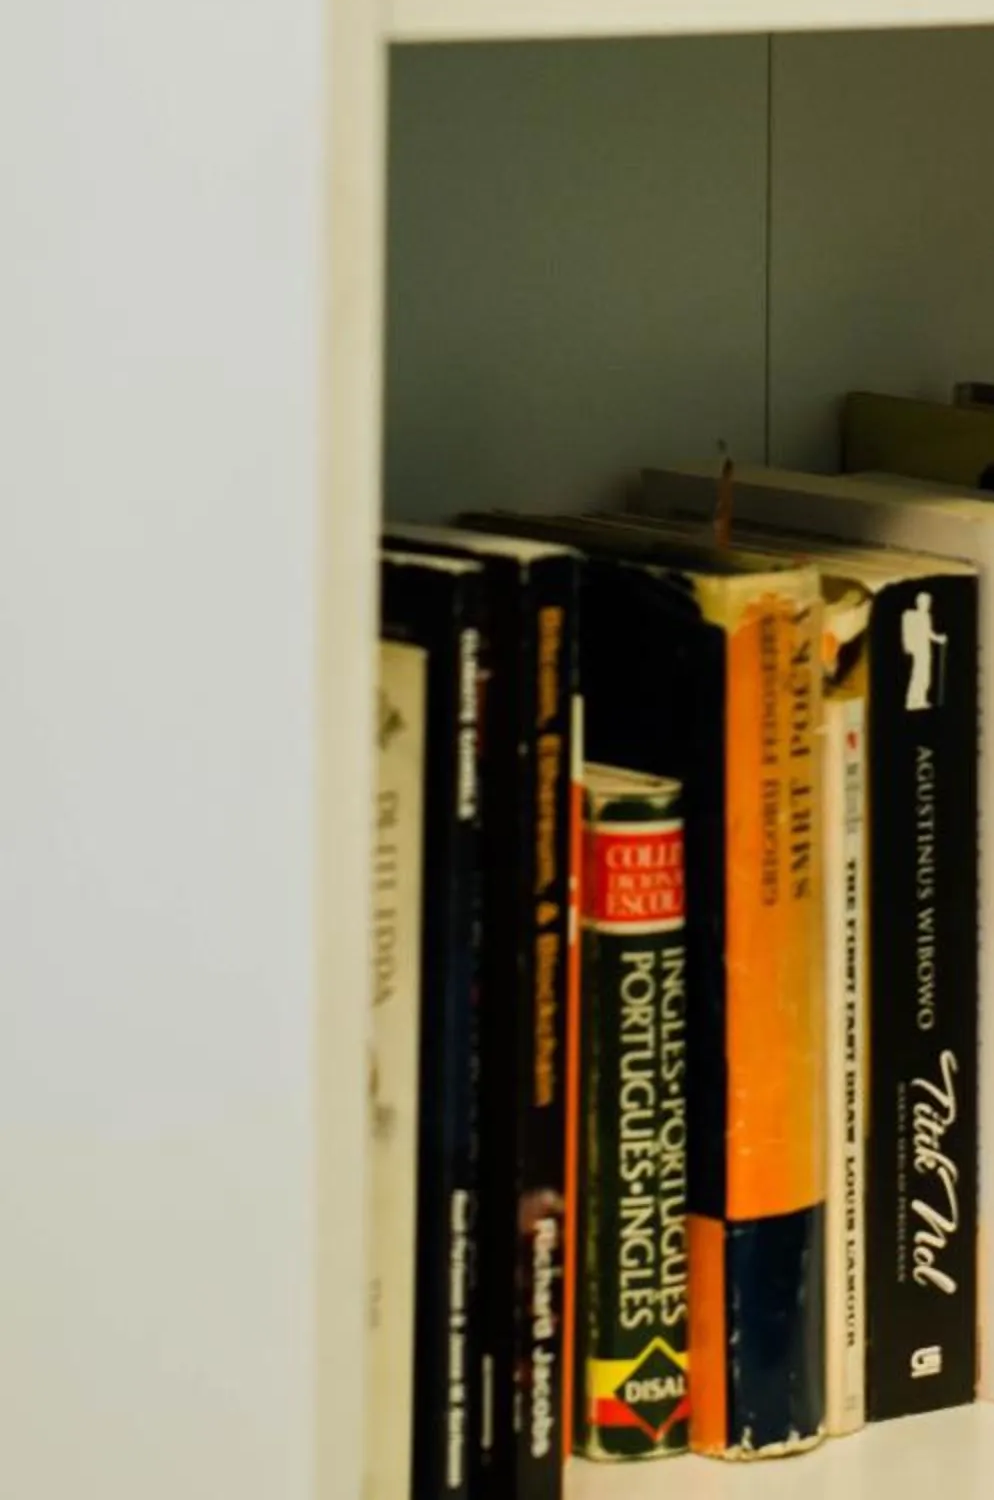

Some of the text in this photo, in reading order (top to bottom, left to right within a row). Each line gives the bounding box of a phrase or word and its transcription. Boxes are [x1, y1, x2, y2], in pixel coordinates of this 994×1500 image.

[536, 606, 564, 729] Bitcoin,
[535, 734, 561, 898] Ethereum,
[789, 783, 814, 899] SMRT
[844, 860, 858, 912] THE
[915, 745, 937, 1031] AGUSTINUS WIBOWO
[844, 917, 858, 996] FIRST
[533, 932, 559, 1107] Blockchain
[843, 1001, 857, 1064] FAST
[843, 1071, 857, 1145] DRAW
[843, 1156, 857, 1231] LOUIS
[911, 1049, 959, 1295] Titik Nol
[531, 1216, 562, 1459] Richard Jacobs
